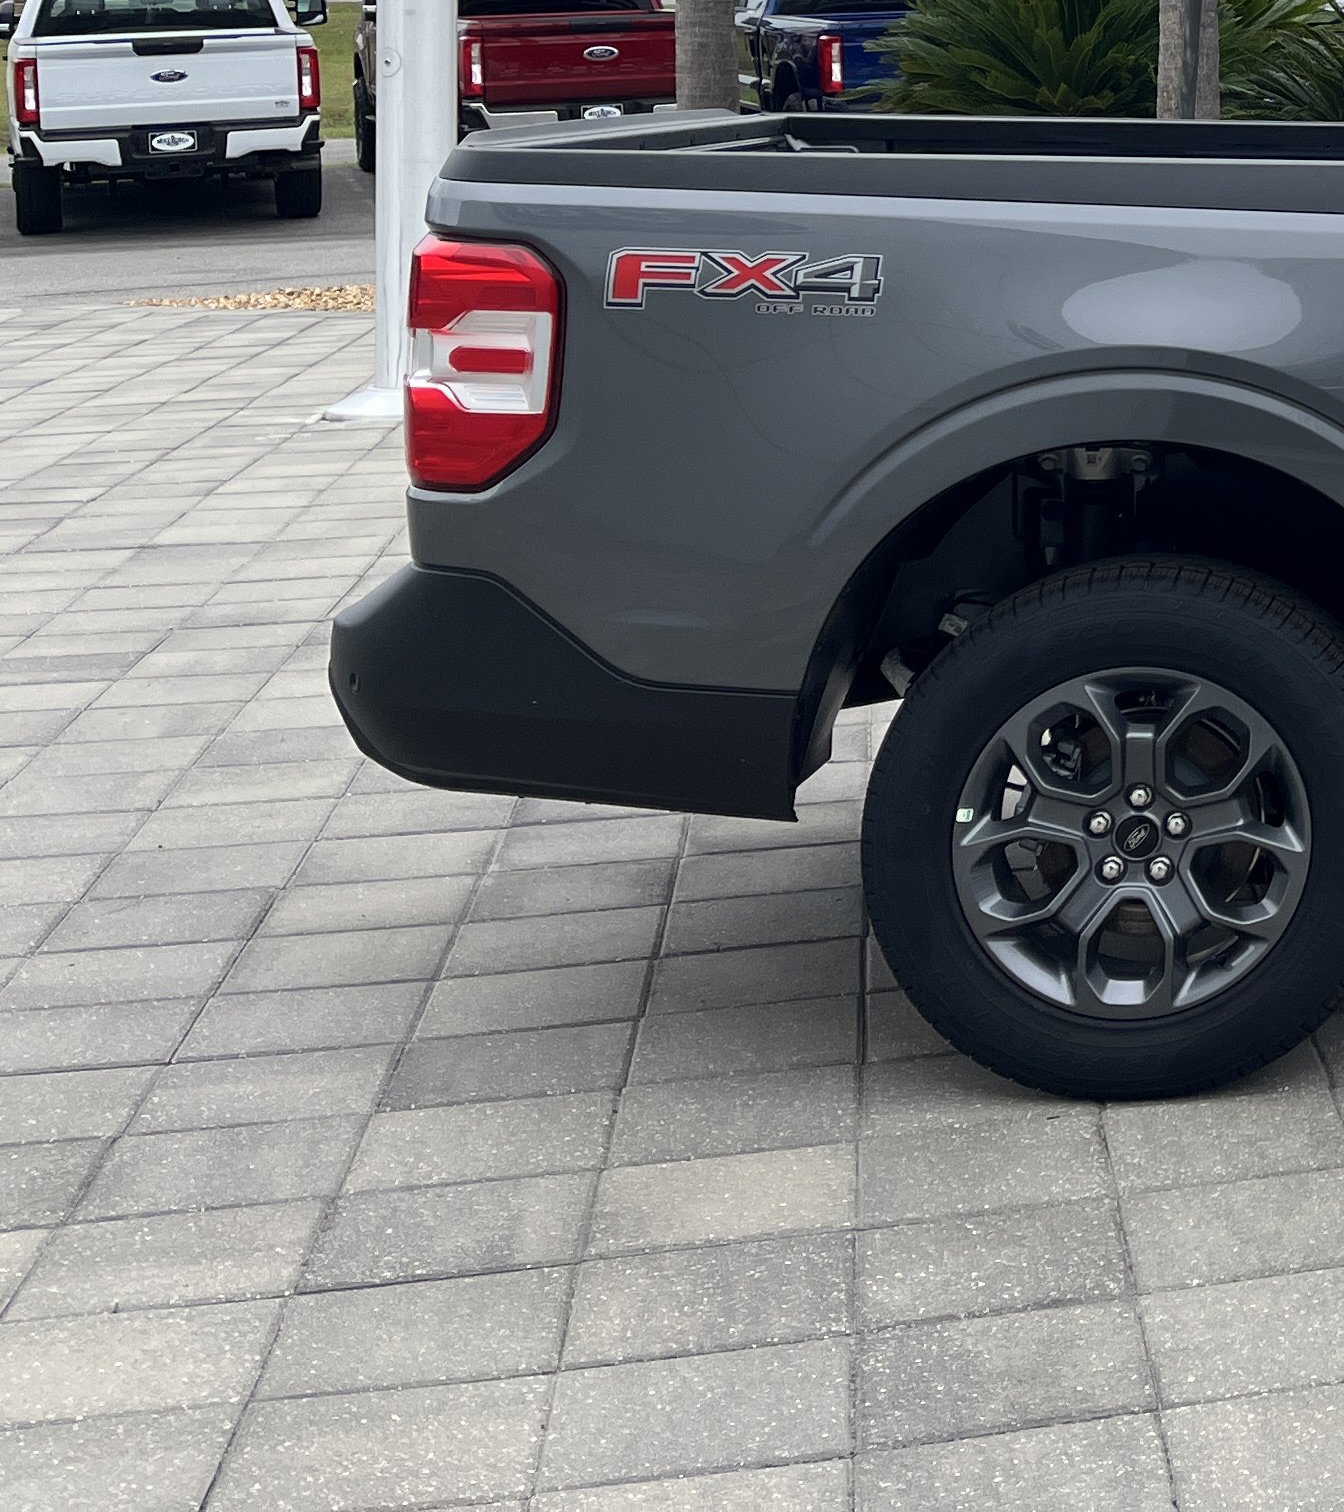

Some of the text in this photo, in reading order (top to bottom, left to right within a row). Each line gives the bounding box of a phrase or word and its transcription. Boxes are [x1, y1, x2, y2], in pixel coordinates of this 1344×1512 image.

[604, 246, 884, 310] FX4
[755, 303, 877, 318] OFF ROAD
